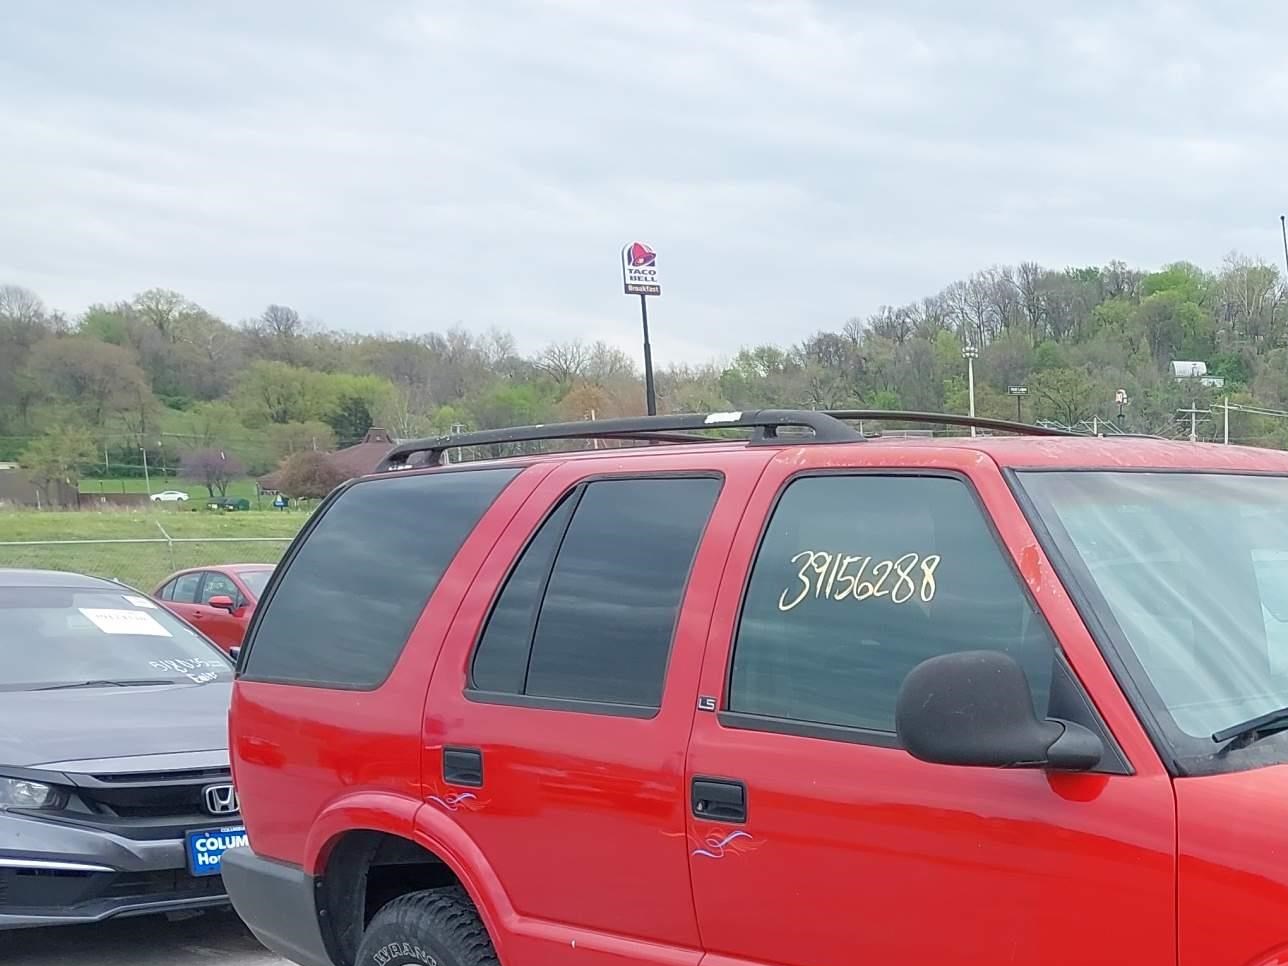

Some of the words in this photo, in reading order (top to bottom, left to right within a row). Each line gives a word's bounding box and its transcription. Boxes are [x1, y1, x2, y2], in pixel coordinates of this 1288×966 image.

[627, 268, 657, 276] TACO
[778, 550, 942, 611] 39156288
[698, 698, 716, 711] LS
[197, 852, 222, 865] Ho
